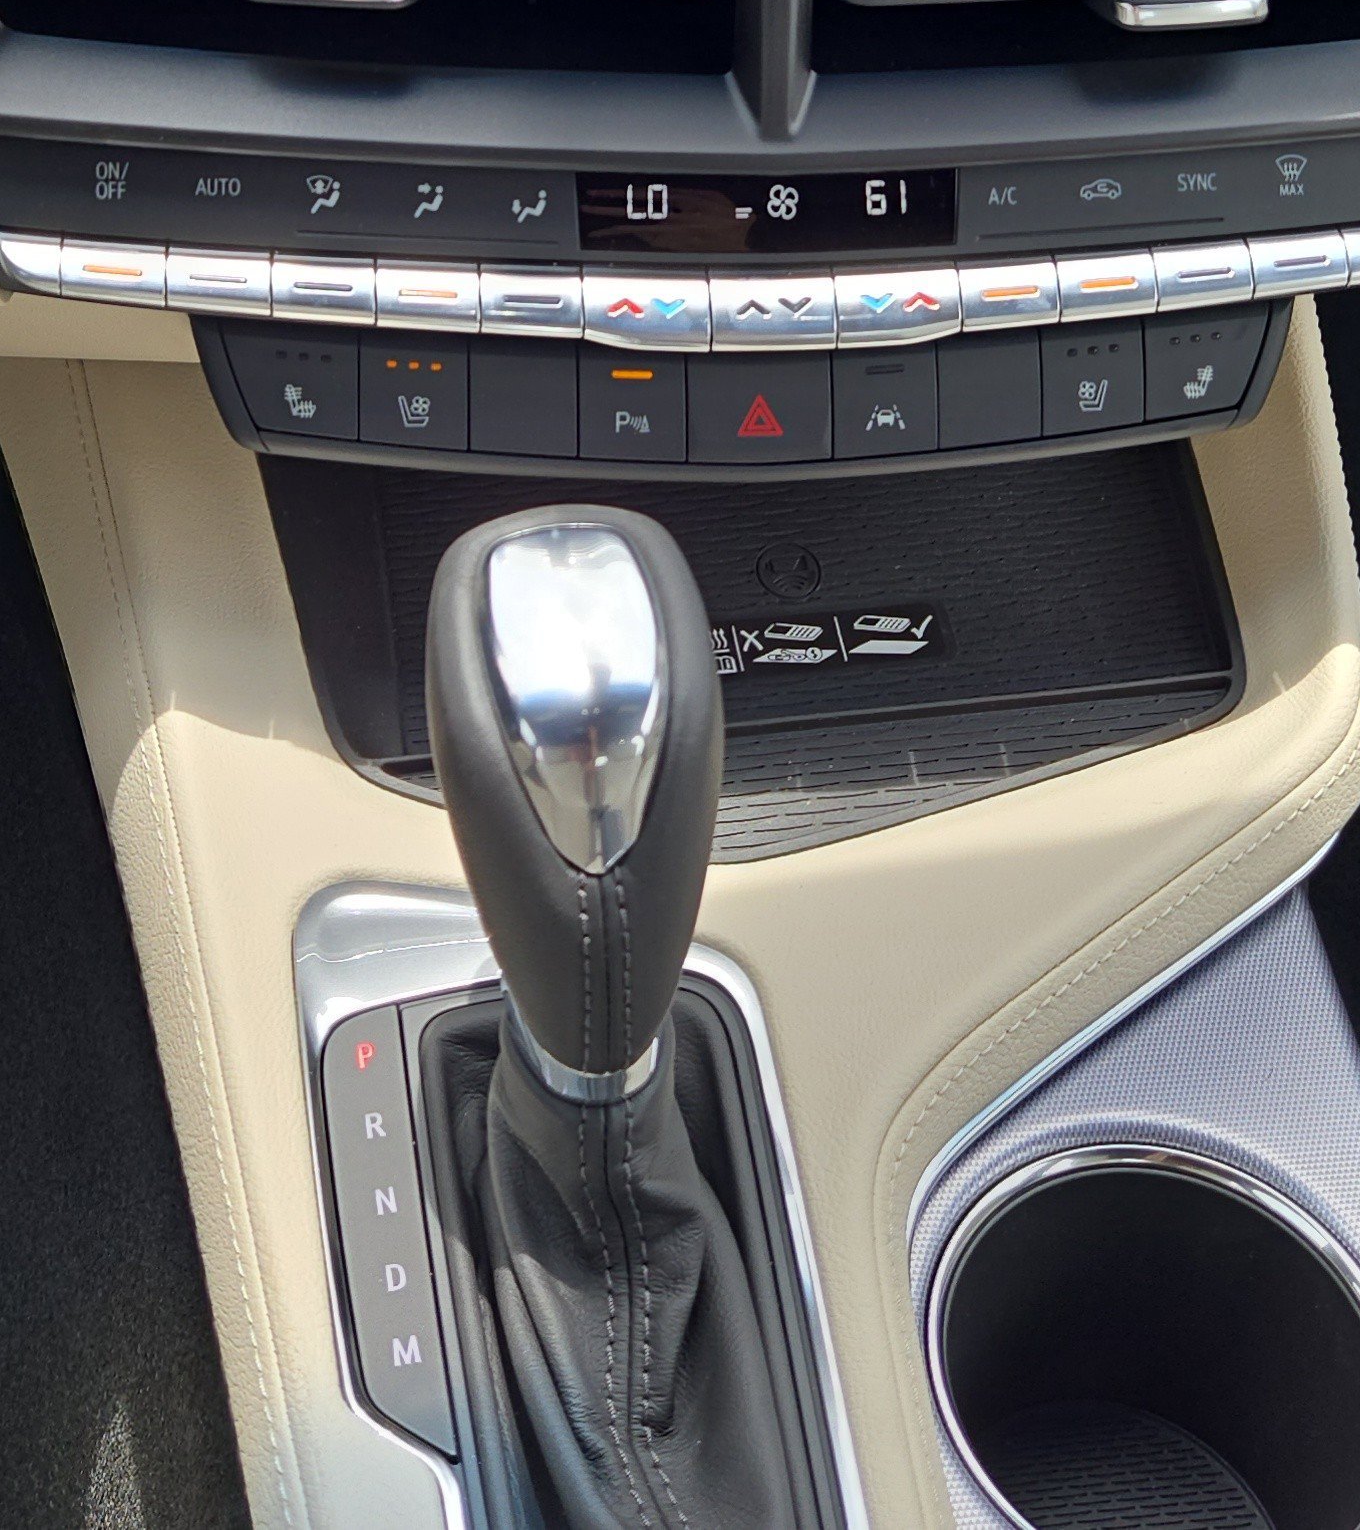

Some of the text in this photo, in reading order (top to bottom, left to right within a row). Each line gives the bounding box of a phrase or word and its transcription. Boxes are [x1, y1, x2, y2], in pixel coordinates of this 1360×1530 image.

[95, 161, 130, 180] ON/
[1177, 172, 1218, 192] SYNC
[95, 181, 127, 200] OFF
[194, 177, 241, 197] AUTO
[865, 179, 908, 215] 61
[988, 186, 1018, 206] A/C
[1279, 183, 1305, 197] MAX
[356, 1041, 376, 1070] P
[364, 1112, 387, 1140] R
[374, 1186, 399, 1216] N
[384, 1263, 408, 1292] D
[392, 1334, 423, 1368] M
